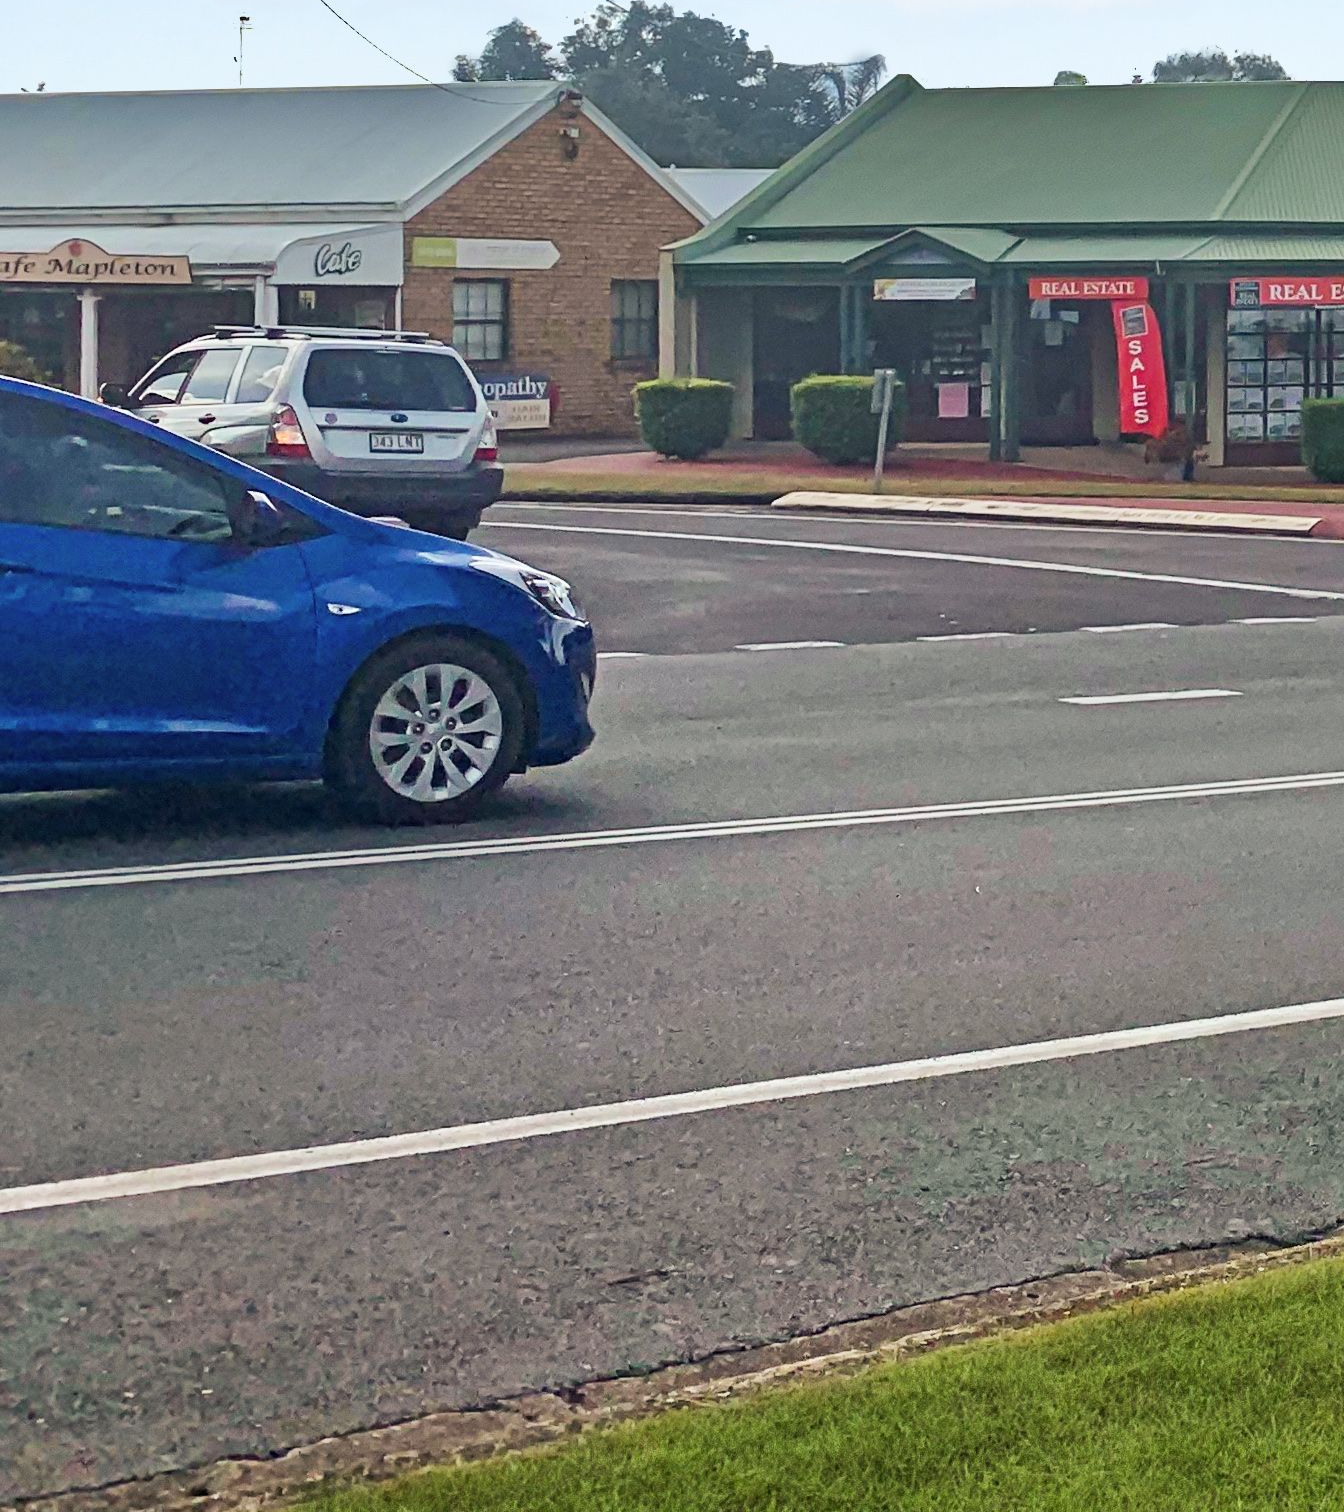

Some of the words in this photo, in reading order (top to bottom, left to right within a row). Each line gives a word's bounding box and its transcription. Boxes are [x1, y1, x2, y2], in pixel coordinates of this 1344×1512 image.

[0, 255, 35, 279] afe
[44, 258, 178, 281] Mapleton
[314, 242, 362, 277] Cafe
[1041, 281, 1080, 296] REAL
[1083, 281, 1136, 295] ESTATE
[1268, 283, 1324, 301] REAL
[481, 375, 548, 399] opathy
[1128, 340, 1149, 424] SALES
